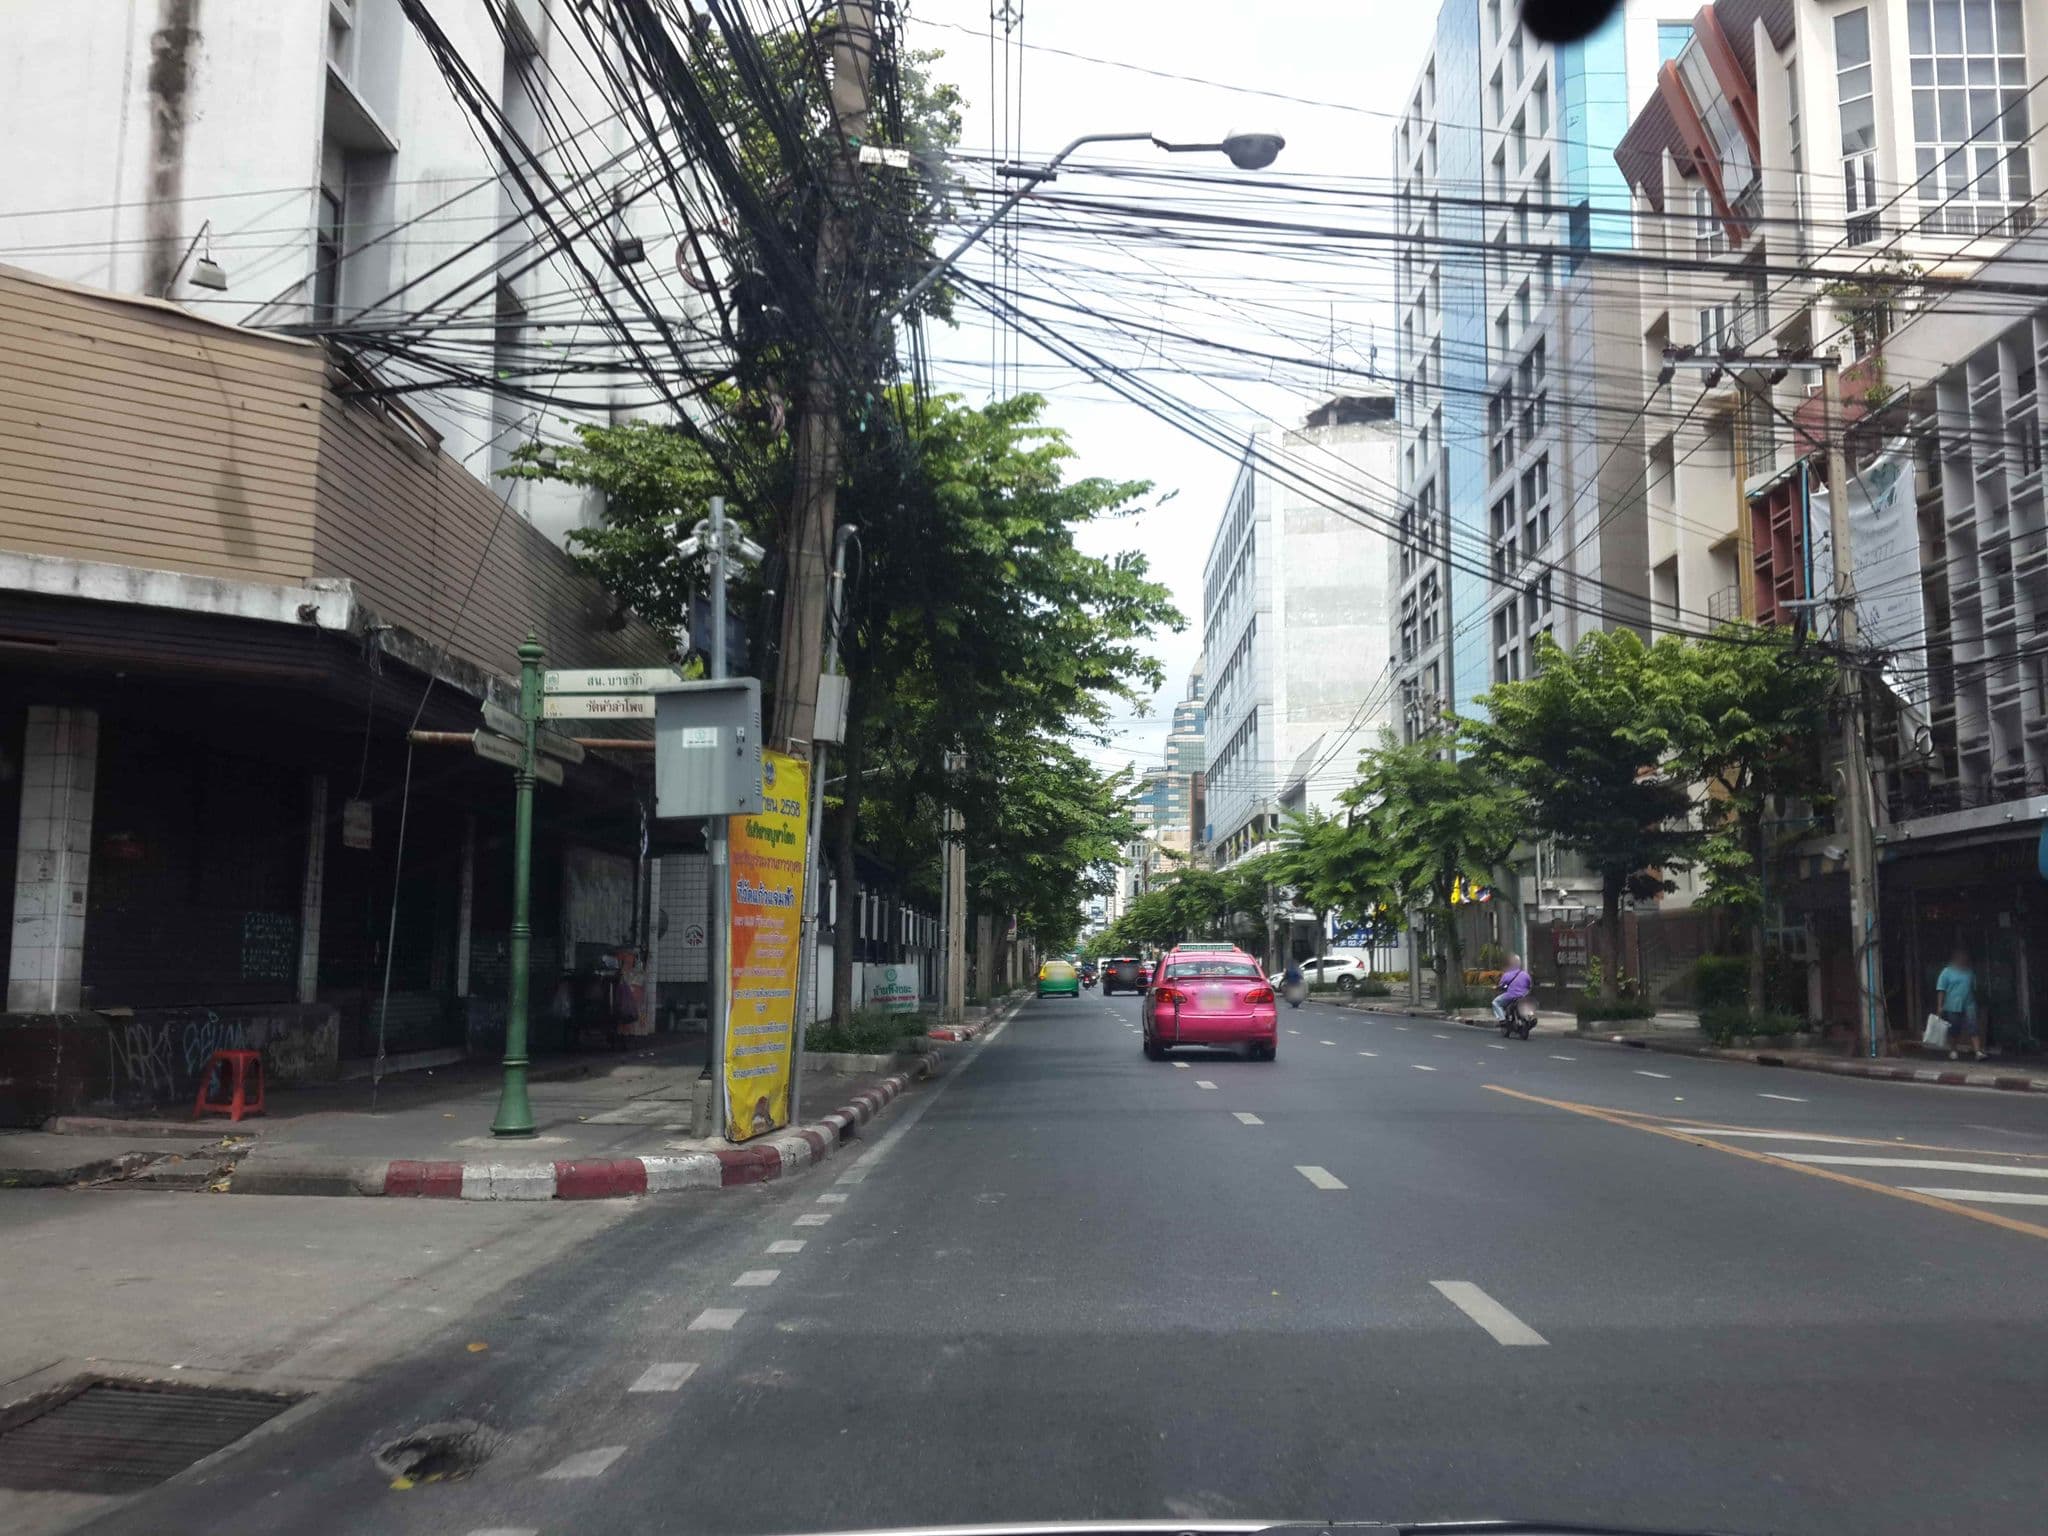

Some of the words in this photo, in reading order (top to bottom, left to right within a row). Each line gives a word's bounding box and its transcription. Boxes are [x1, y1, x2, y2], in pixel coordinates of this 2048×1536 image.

[607, 672, 643, 688] บางรัก
[585, 699, 644, 714] วัดหัวลำโพง
[780, 798, 800, 818] 2558
